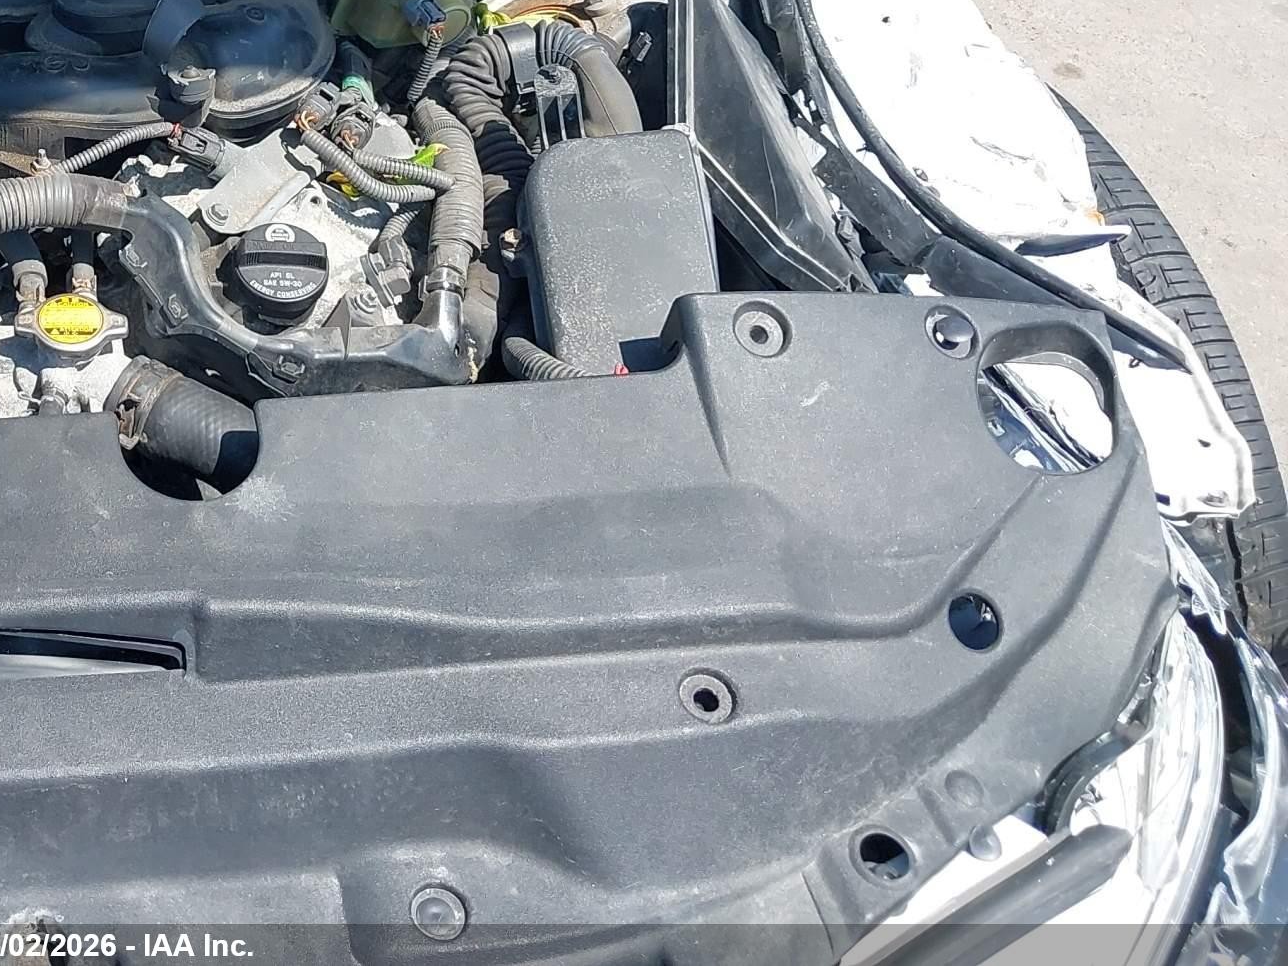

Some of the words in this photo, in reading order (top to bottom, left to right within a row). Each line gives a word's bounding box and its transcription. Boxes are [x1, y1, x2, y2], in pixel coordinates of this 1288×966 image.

[249, 280, 275, 297] ENERGY
[276, 281, 317, 298] CONSERVING
[279, 280, 303, 288] 5W-30
